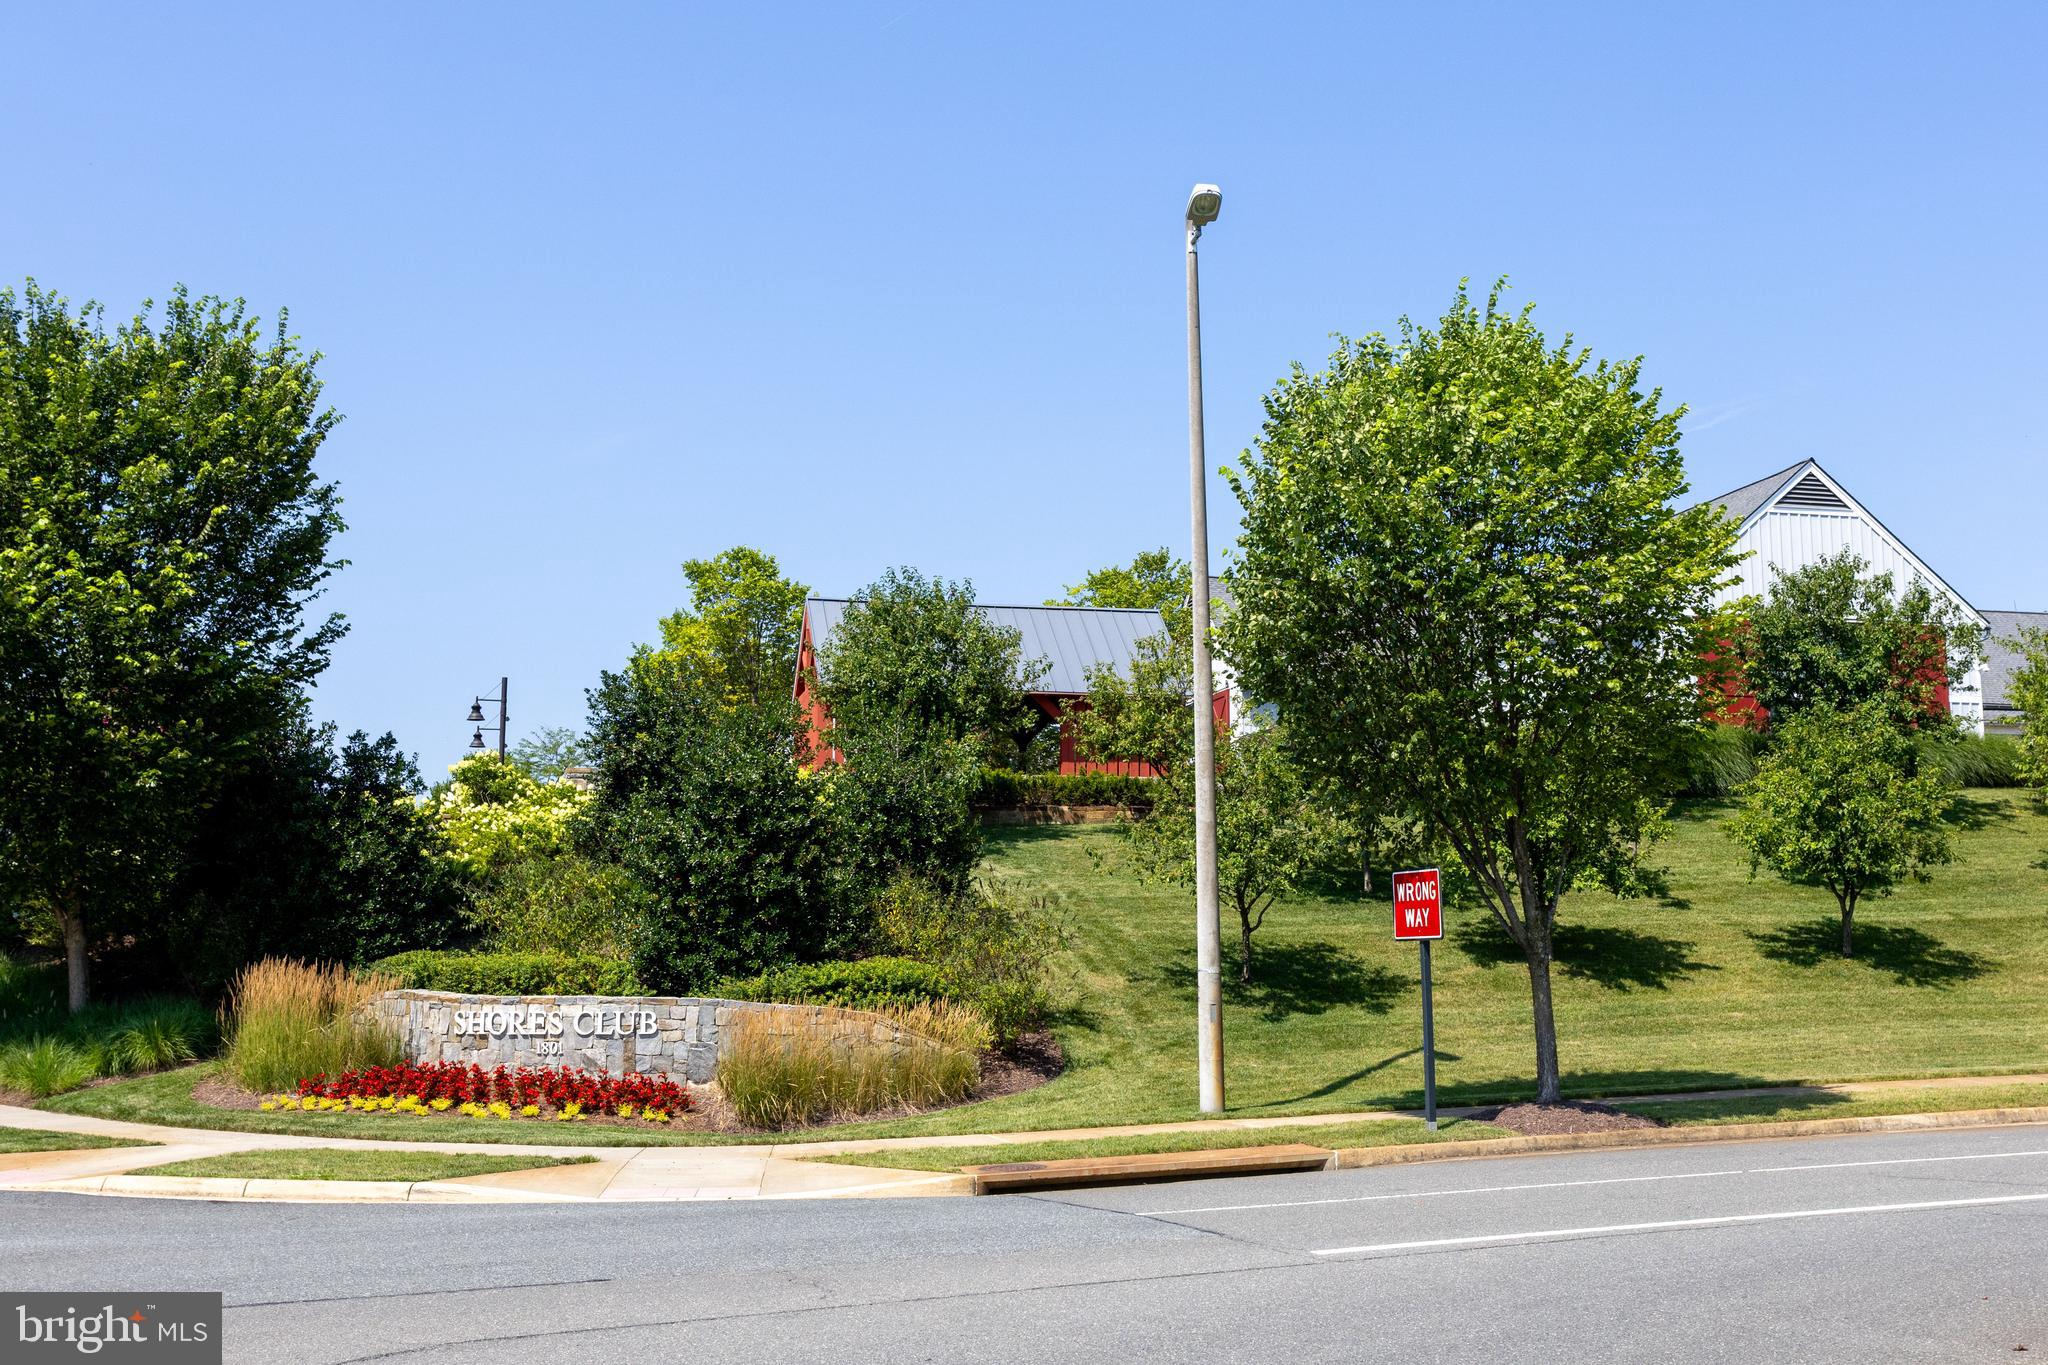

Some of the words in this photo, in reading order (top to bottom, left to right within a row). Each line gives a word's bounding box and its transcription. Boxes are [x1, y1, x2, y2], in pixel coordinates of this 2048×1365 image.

[1396, 881, 1437, 902] WRONG
[1405, 907, 1430, 928] WAY
[454, 1010, 564, 1037] SHORES
[573, 1010, 659, 1037] CLUB
[536, 1041, 564, 1056] 1801
